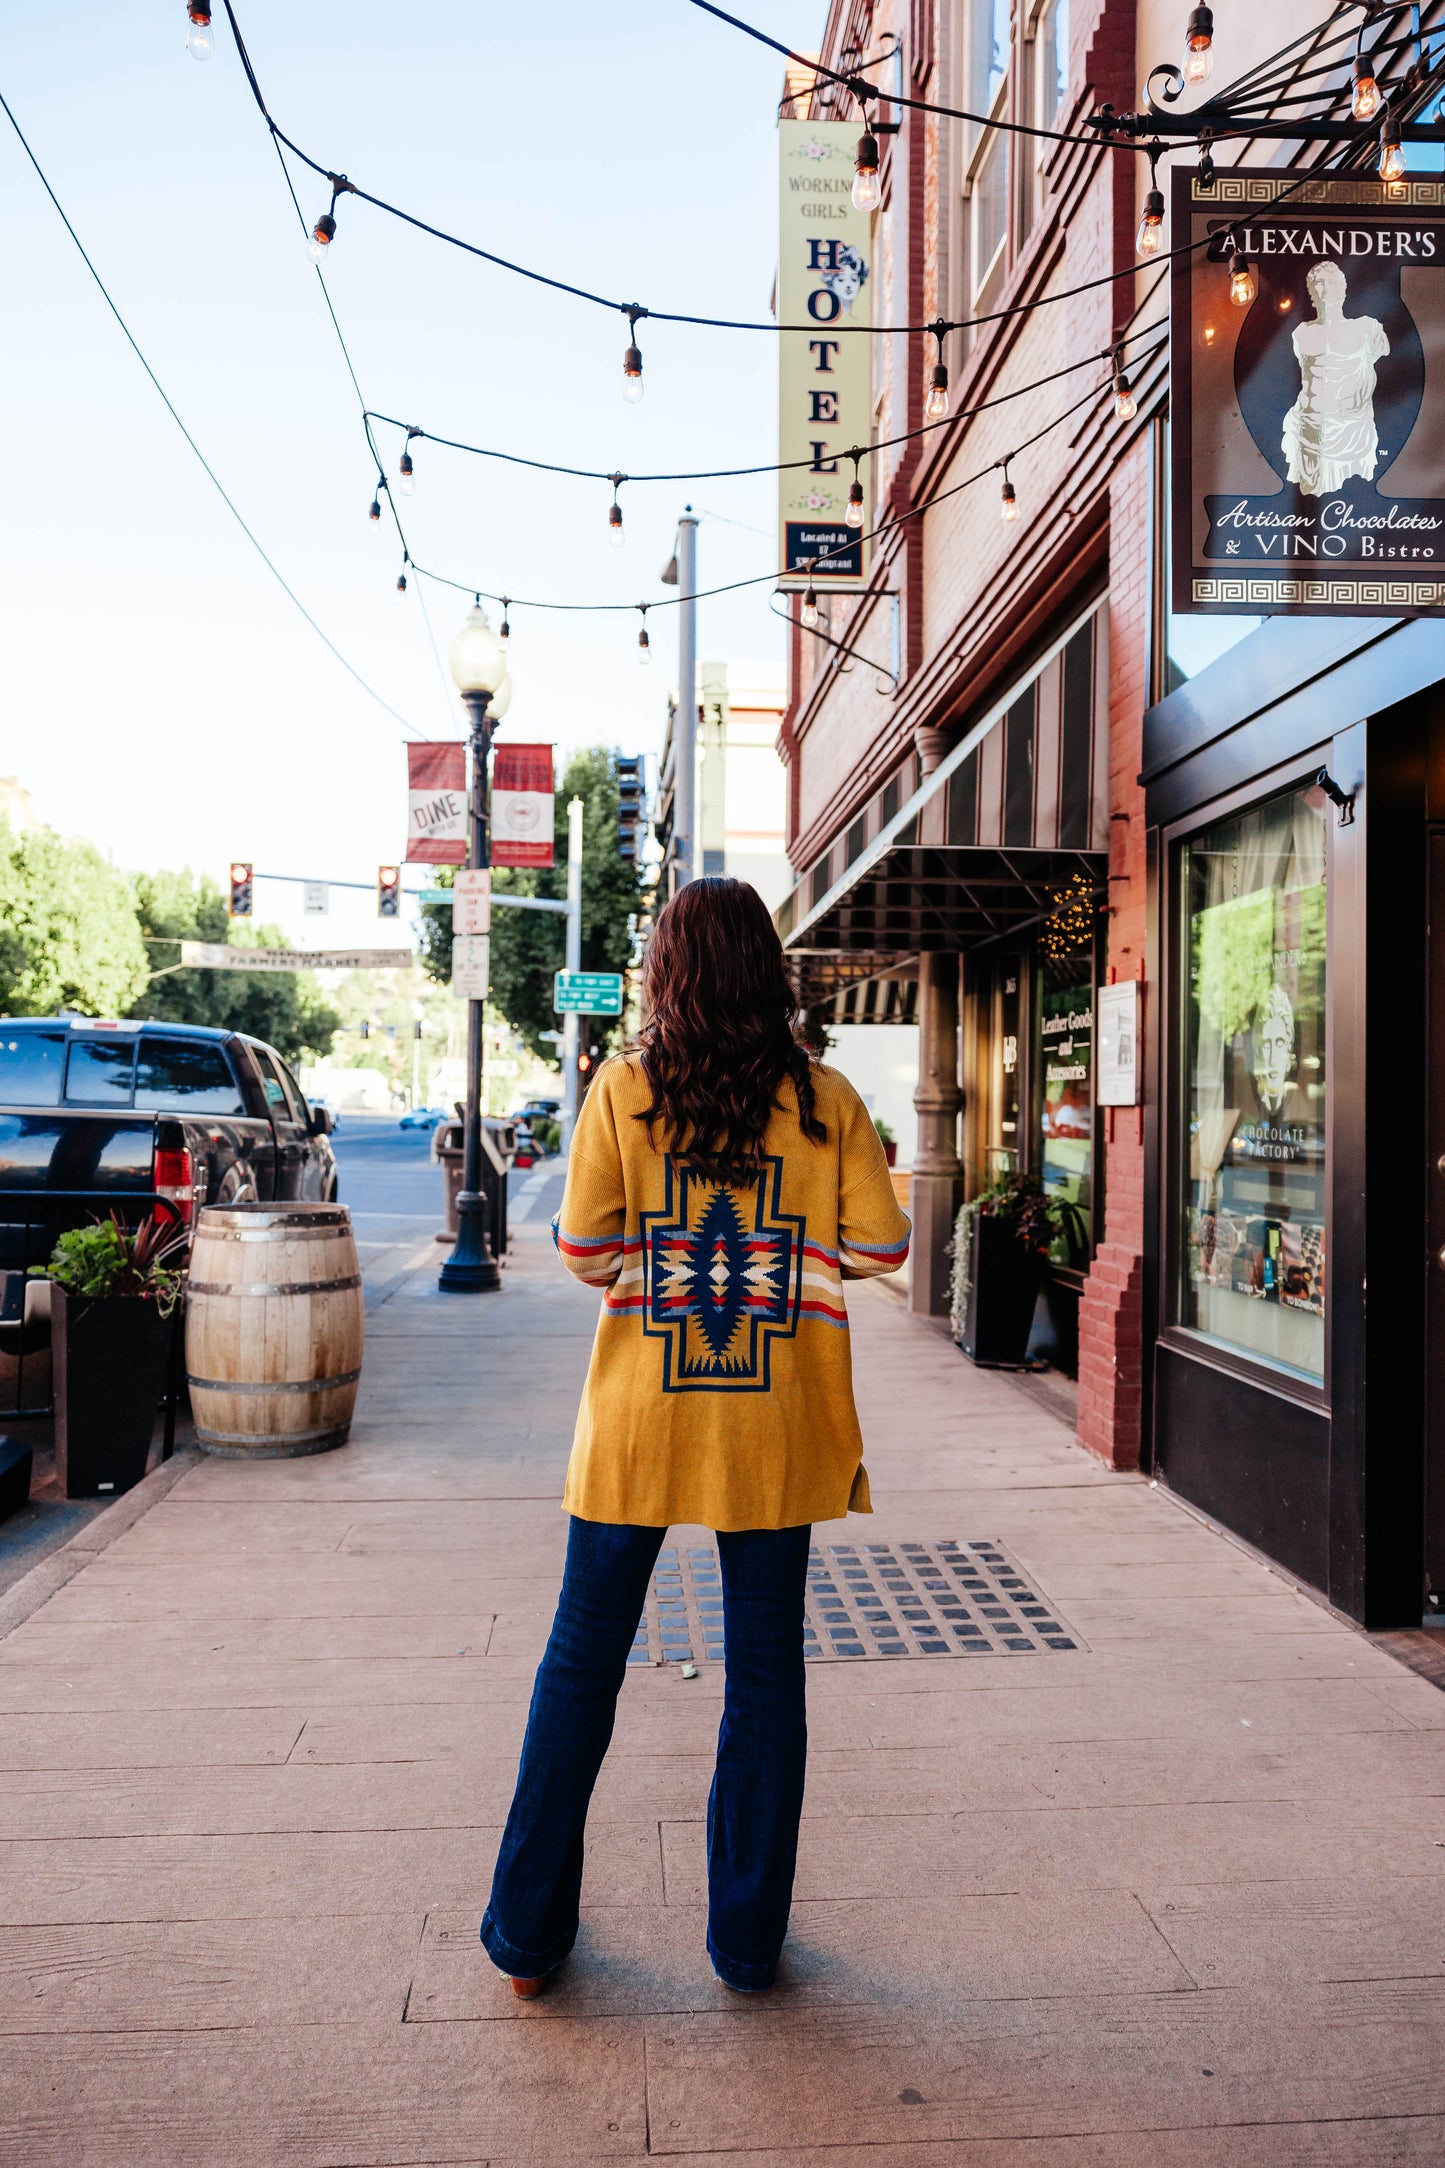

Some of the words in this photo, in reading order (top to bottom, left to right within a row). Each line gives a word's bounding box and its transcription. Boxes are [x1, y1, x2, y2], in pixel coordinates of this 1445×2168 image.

[788, 176, 854, 193] WORKIN
[800, 202, 848, 219] GIRLS
[1219, 228, 1436, 258] ALEXANDER'S
[806, 238, 844, 476] HOTEL
[1216, 499, 1316, 528] Artisan
[1320, 500, 1443, 531] Chocolates
[1225, 539, 1241, 555] &
[1255, 534, 1347, 557] VINO
[1361, 535, 1435, 558] Bistro
[413, 792, 461, 829] DINE
[1041, 1013, 1068, 1035] Leather
[1068, 1007, 1092, 1030] Goods
[1242, 1125, 1304, 1143] CHOCOLATE
